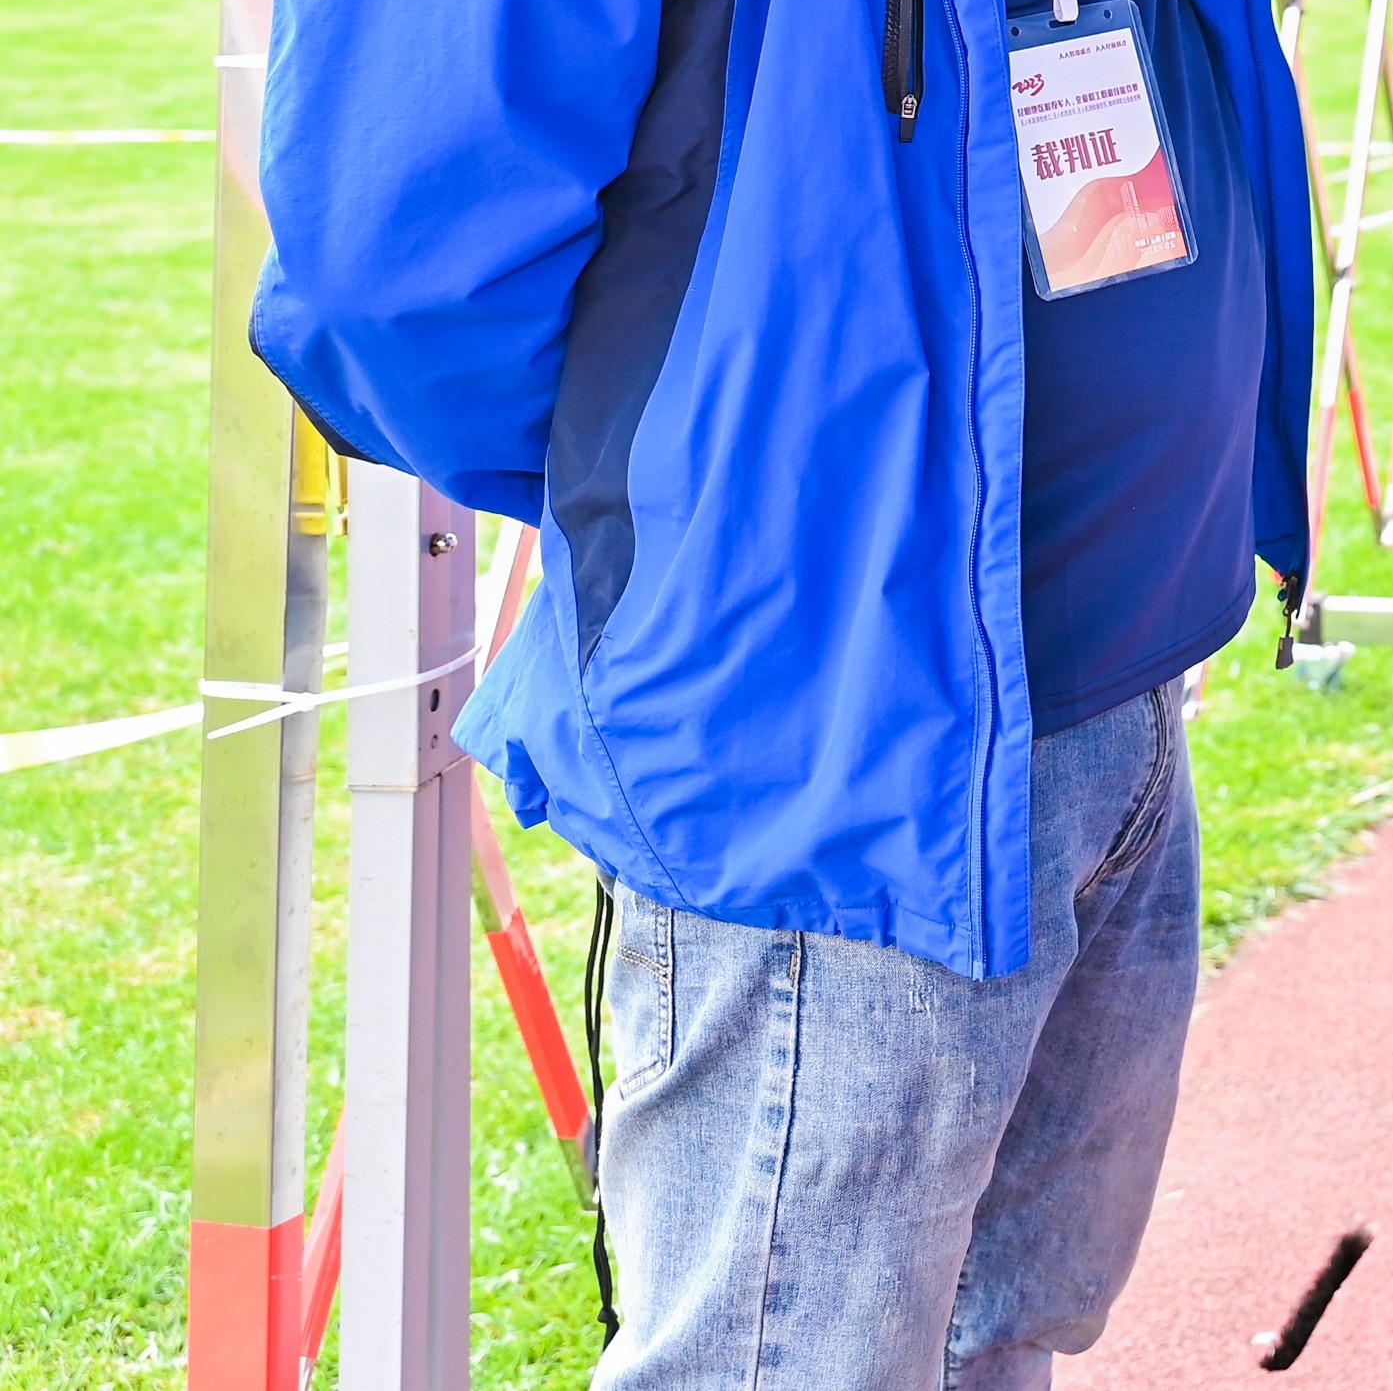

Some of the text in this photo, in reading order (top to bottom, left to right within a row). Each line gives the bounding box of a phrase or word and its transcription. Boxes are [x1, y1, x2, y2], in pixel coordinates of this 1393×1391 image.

[1011, 72, 1045, 97] 2023
[1030, 127, 1122, 181] 裁判证
